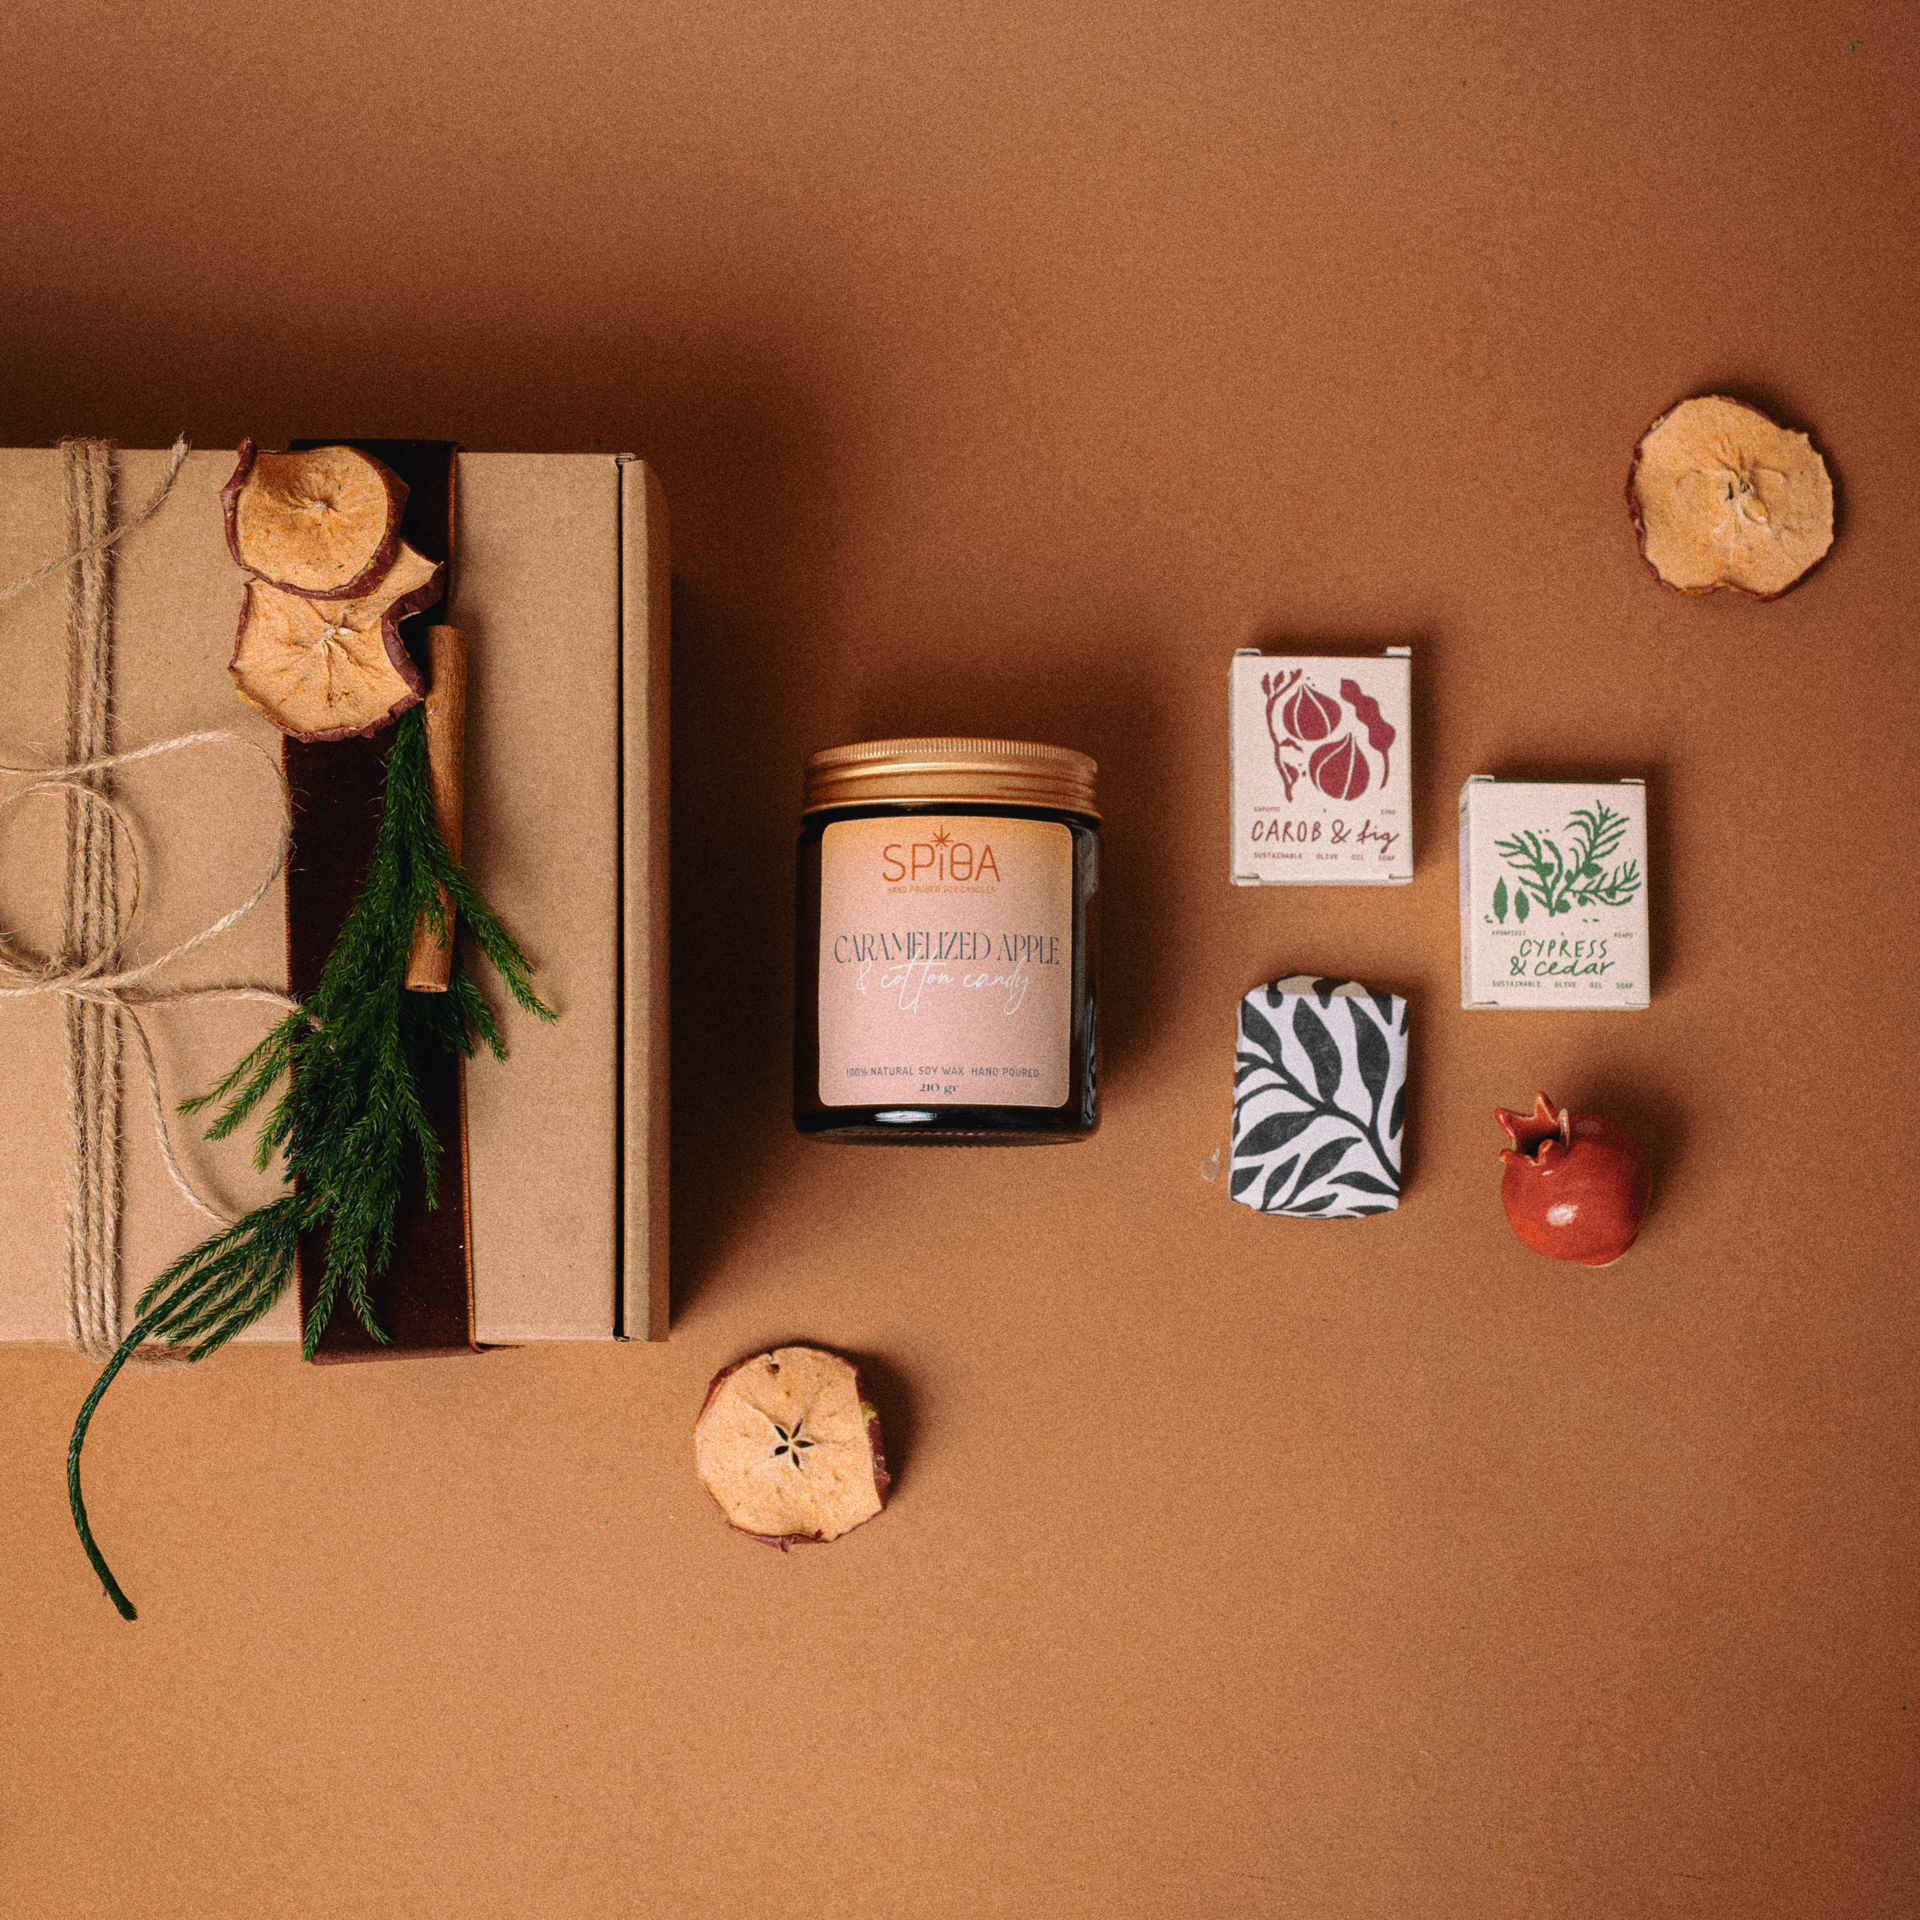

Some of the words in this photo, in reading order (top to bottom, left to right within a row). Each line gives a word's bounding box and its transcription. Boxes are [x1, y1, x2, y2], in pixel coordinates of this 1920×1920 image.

[1251, 819, 1322, 843] CAROB
[1331, 819, 1352, 844] &
[1356, 819, 1400, 854] fig
[1253, 852, 1304, 860] SUSTAINABLE
[1315, 853, 1339, 861] OLIVE
[1377, 854, 1397, 862] SOAP
[886, 886, 907, 894] HAND
[834, 931, 992, 964] CARAMELIZED
[997, 933, 1060, 965] APPLE
[1520, 939, 1608, 959] CYPRESS
[1510, 956, 1527, 976] &
[1534, 959, 1616, 977] cedar
[855, 958, 873, 996] &
[880, 948, 955, 1014] cotton
[963, 955, 1034, 1015] candy
[1492, 980, 1542, 988] SUSTAINABLE
[845, 1067, 868, 1077] 100%
[870, 1066, 915, 1076] NATURAL
[918, 1066, 939, 1076] SOY
[942, 1066, 965, 1076] WAX
[971, 1067, 999, 1076] HAND
[1002, 1068, 1040, 1078] POURED
[919, 1083, 940, 1092] 210
[943, 1084, 960, 1095] gr
